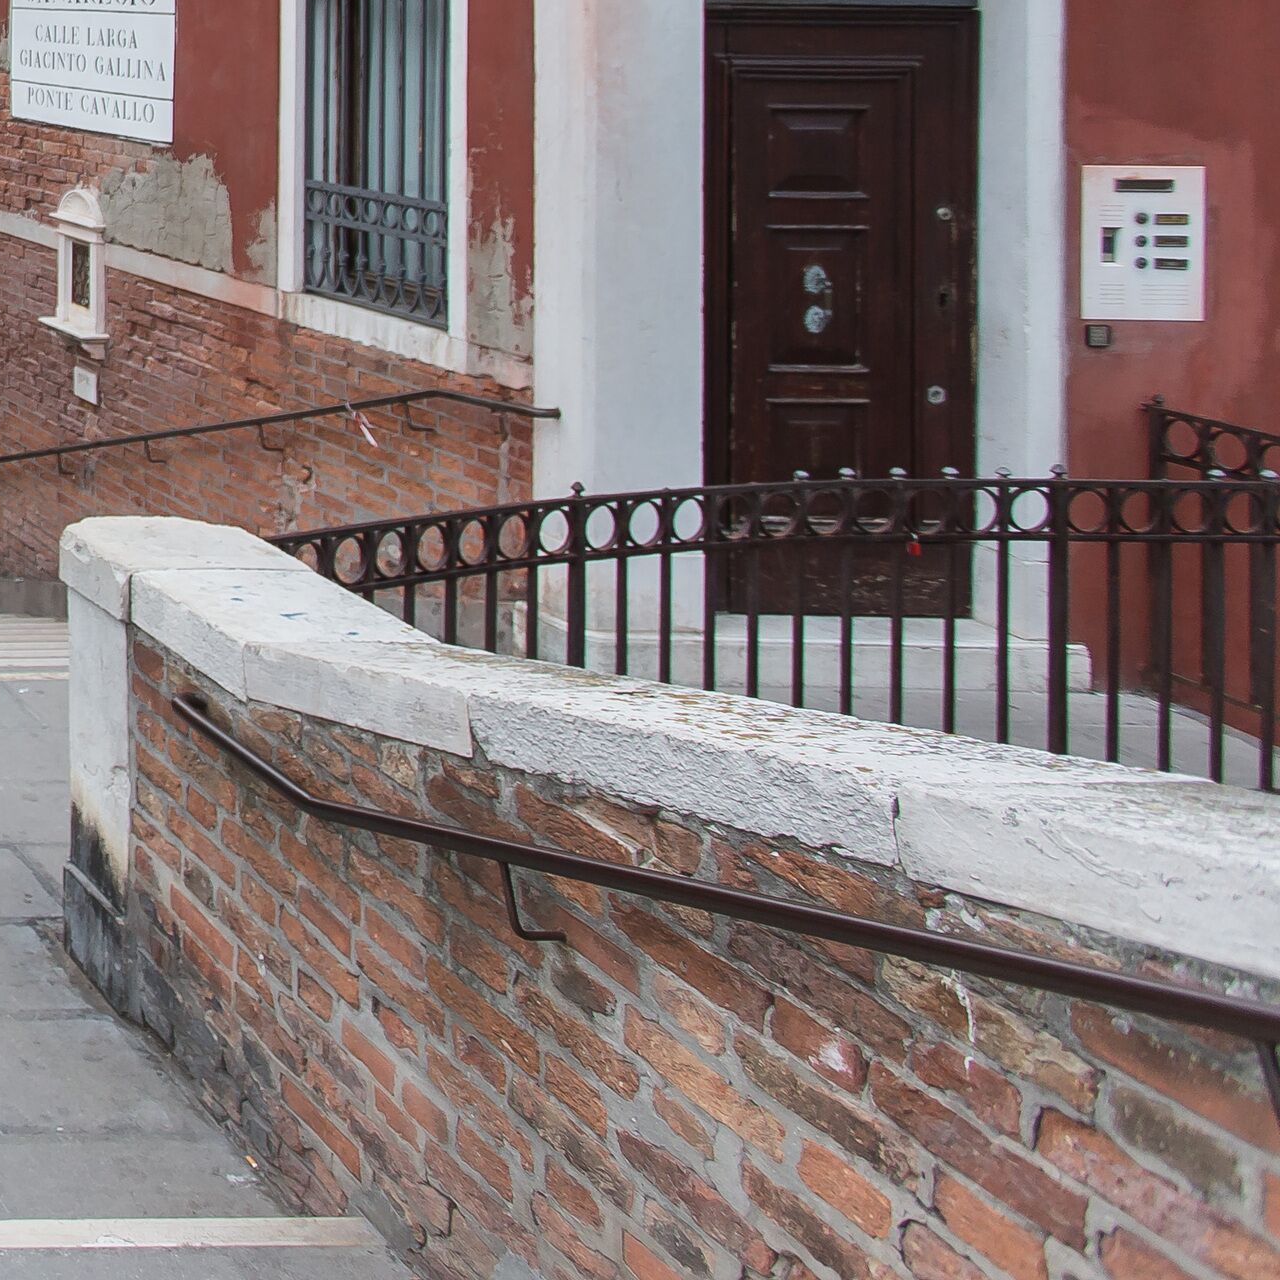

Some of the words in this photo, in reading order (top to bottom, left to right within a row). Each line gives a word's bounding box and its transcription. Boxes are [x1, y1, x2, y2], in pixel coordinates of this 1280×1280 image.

[35, 24, 80, 45] CALLE
[87, 27, 138, 49] LARGA
[20, 49, 87, 73] GIACINTO
[95, 56, 166, 82] GALLINA
[27, 87, 73, 111] PONTE
[81, 96, 155, 123] CAVALLO
